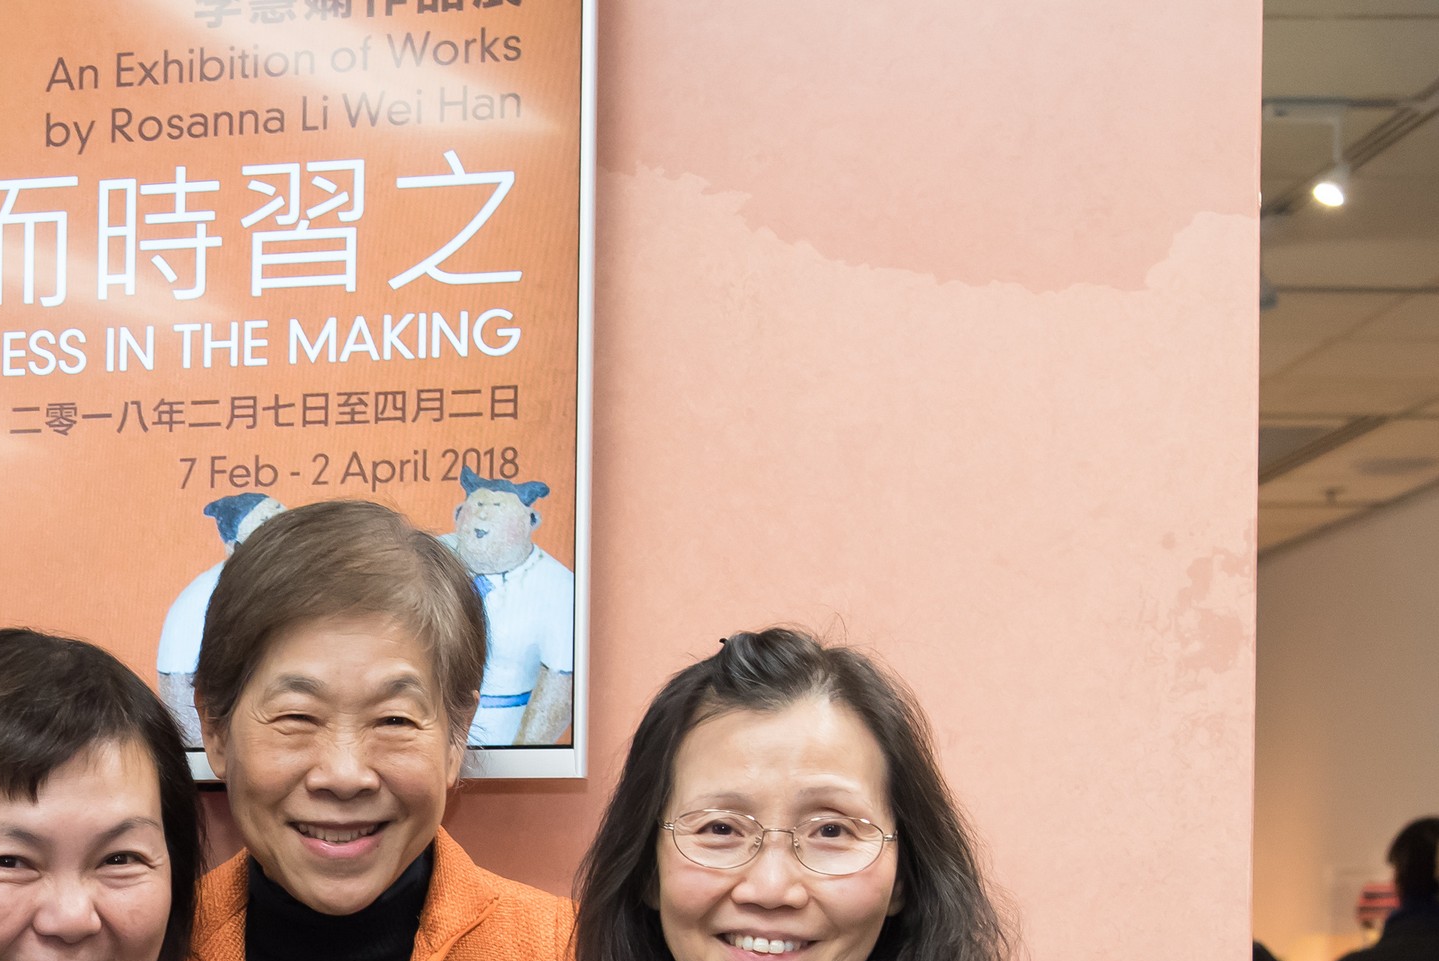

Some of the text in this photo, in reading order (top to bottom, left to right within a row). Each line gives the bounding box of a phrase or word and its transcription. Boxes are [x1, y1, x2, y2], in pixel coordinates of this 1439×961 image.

[46, 27, 523, 93] An Exhibition of Works
[46, 84, 522, 152] by Rosanna Li Wei Han
[105, 325, 155, 373] IN
[173, 319, 269, 370] THE
[289, 308, 522, 365] MAKING
[9, 384, 521, 438] 二零一八年二月七日至四月二日
[178, 457, 194, 490] 7
[209, 453, 281, 489] Feb
[310, 454, 330, 485] 2
[339, 448, 433, 494] April
[441, 446, 520, 483] 2018
